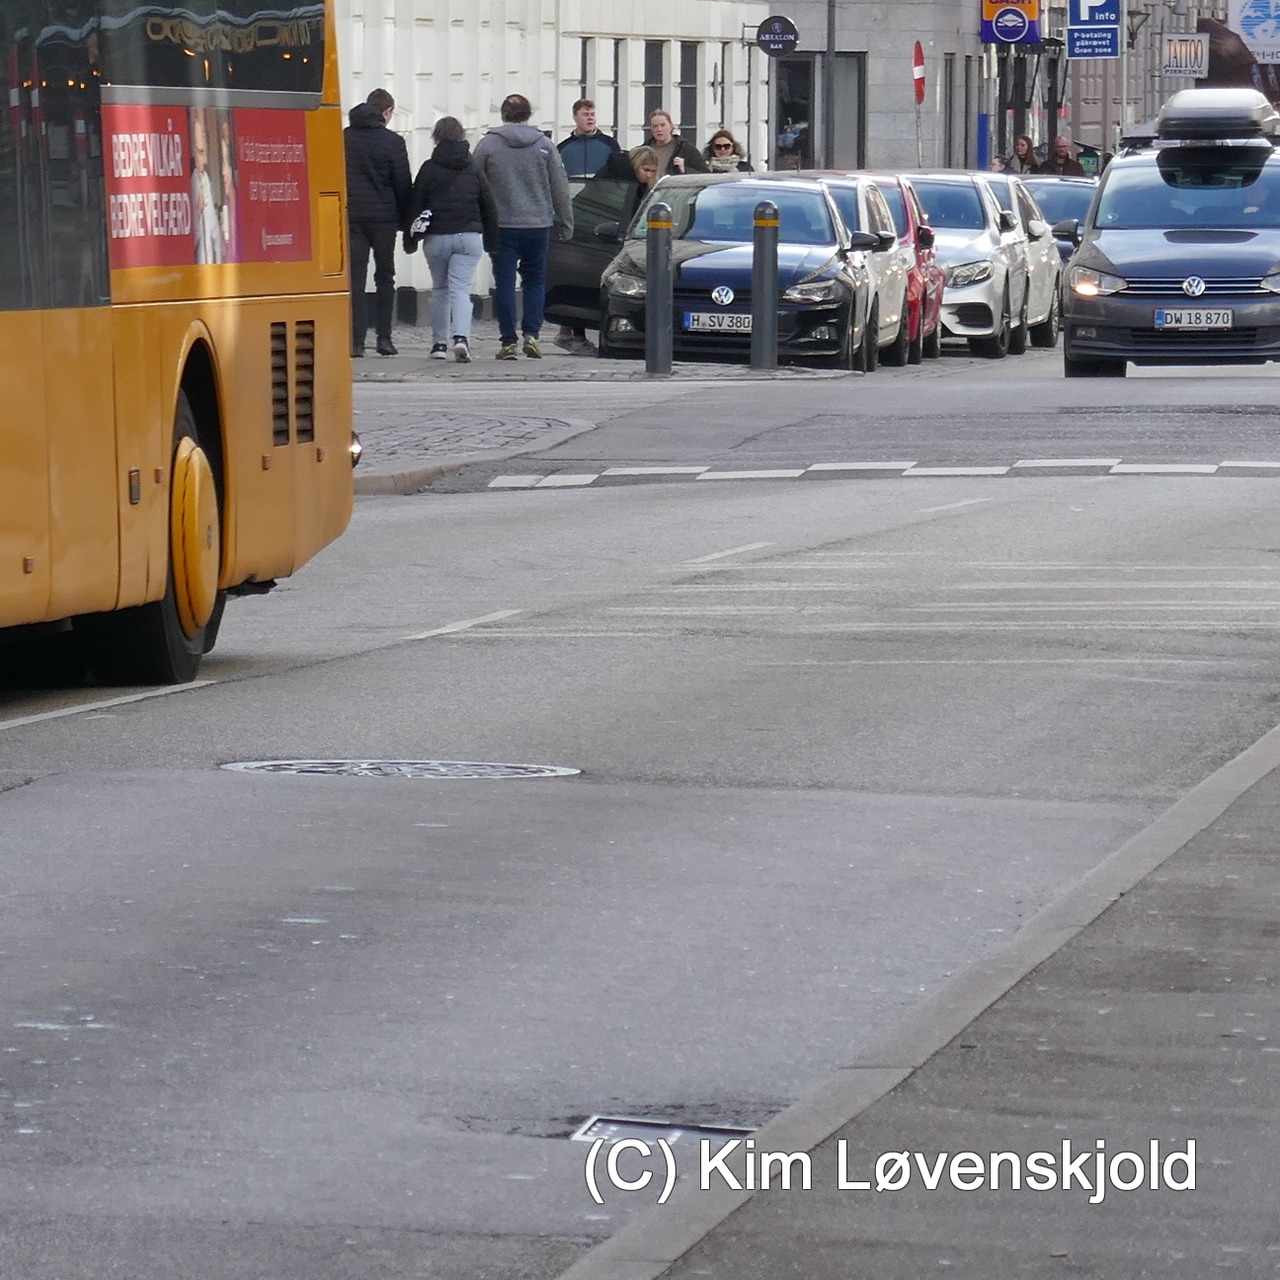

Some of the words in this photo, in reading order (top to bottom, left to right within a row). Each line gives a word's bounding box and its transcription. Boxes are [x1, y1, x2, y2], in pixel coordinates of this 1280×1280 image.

[1095, 12, 1116, 20] info
[1163, 39, 1203, 68] TATTOO
[708, 316, 725, 327] SV
[1165, 312, 1182, 324] DW
[1187, 312, 1202, 324] 18
[1206, 312, 1229, 324] 870
